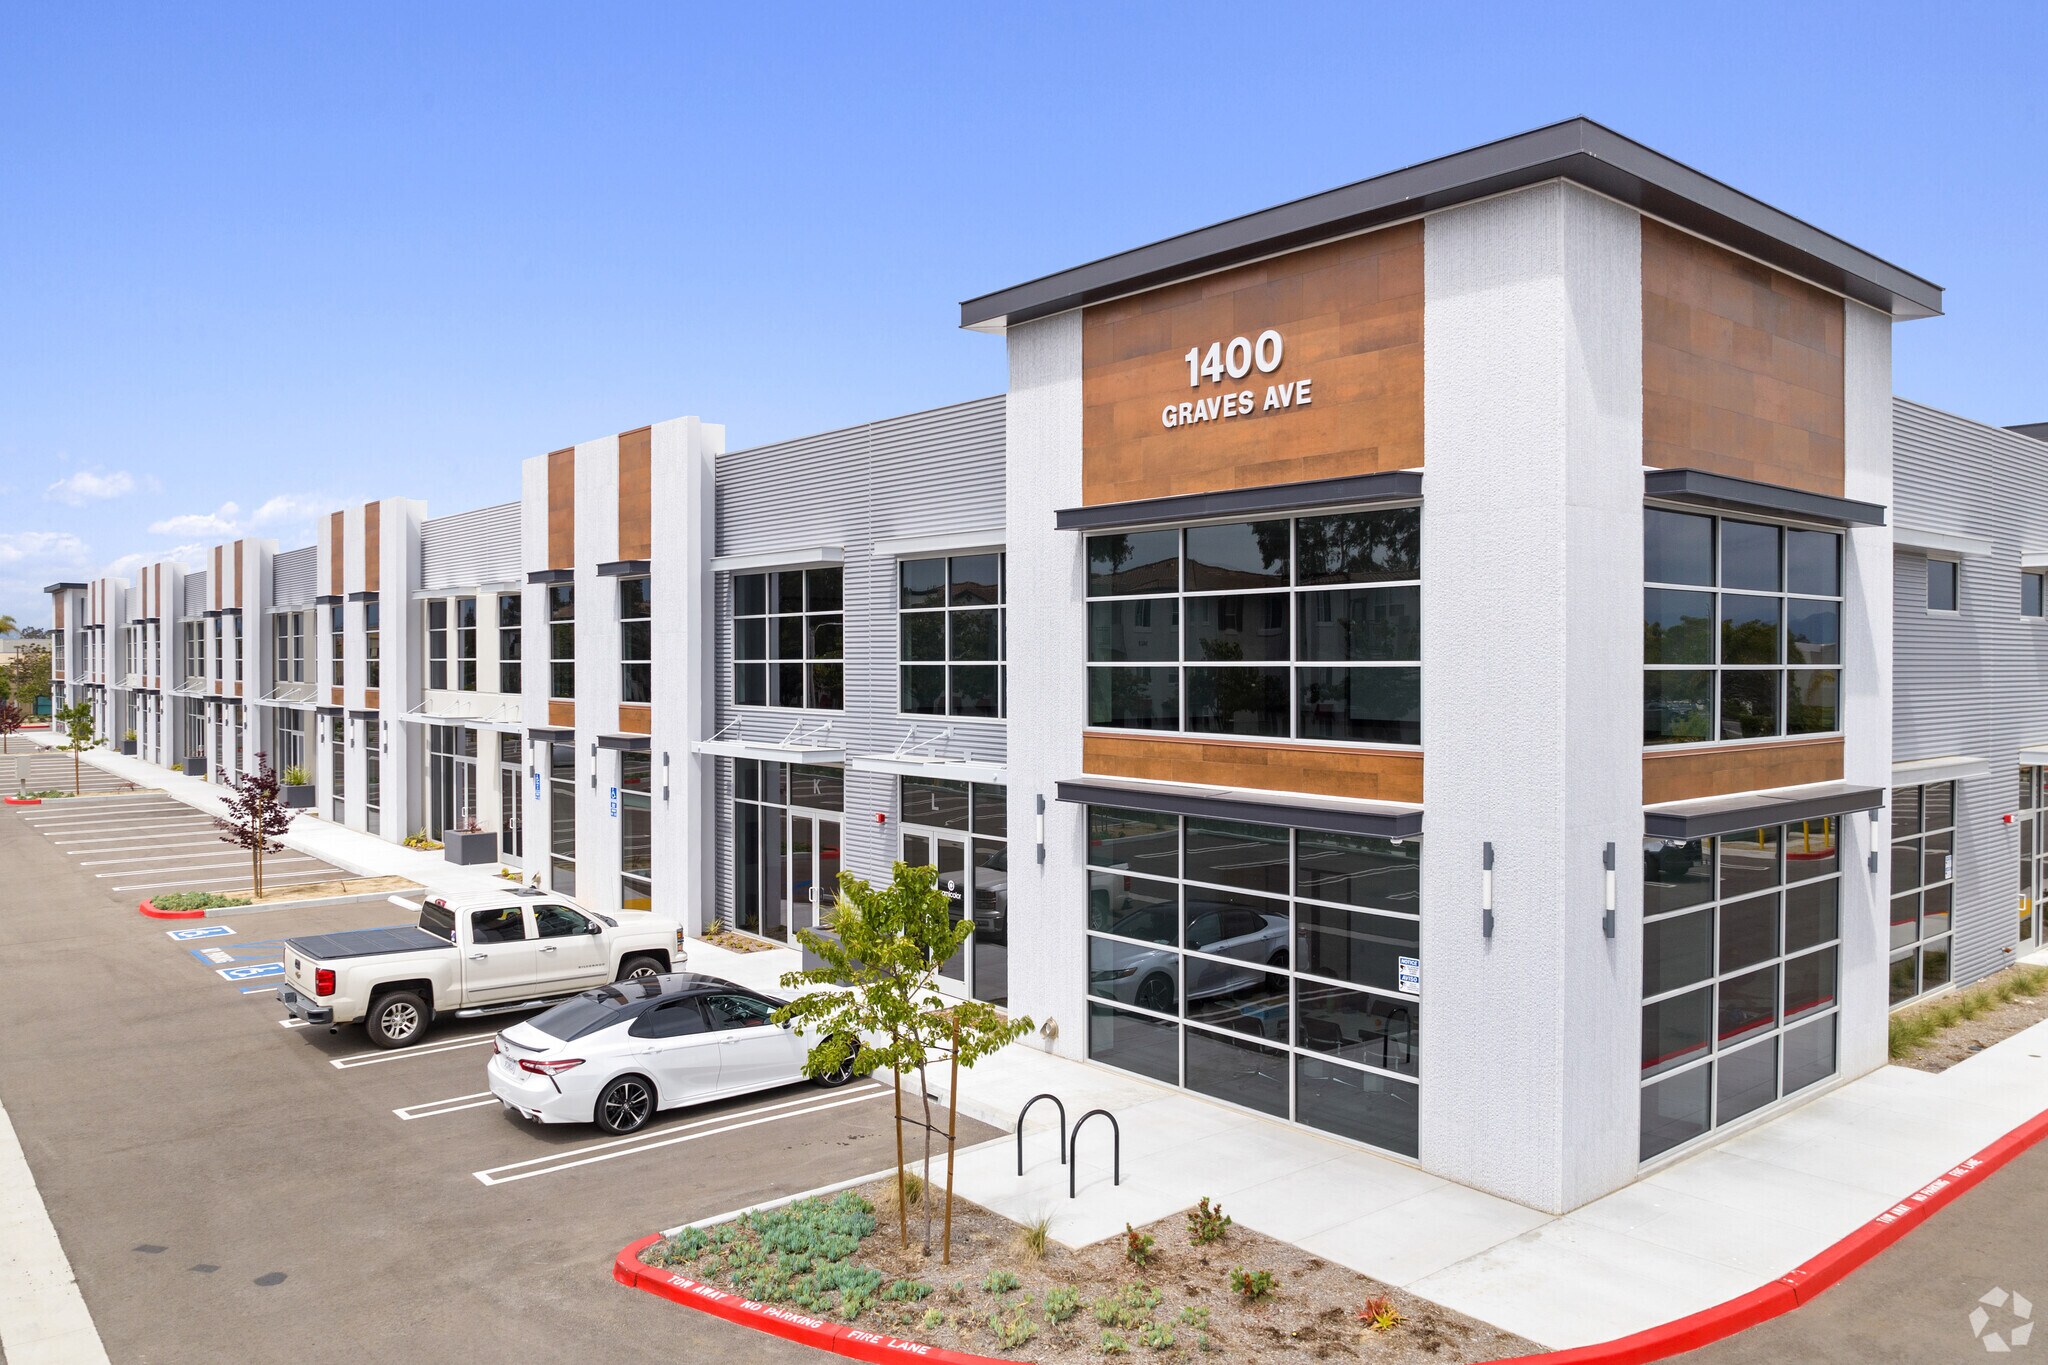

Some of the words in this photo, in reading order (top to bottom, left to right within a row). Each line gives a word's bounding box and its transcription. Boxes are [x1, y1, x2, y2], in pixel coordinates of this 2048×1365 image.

[1184, 329, 1284, 388] 1400
[1162, 390, 1255, 429] GRAVES
[1263, 379, 1312, 412] AVE
[813, 779, 822, 795] K
[931, 793, 939, 810] L
[667, 1275, 695, 1289] TOW
[692, 1285, 729, 1300] AWAY
[740, 1300, 763, 1311] NO
[763, 1308, 824, 1329] PARKING
[847, 1330, 883, 1344] FIRE
[887, 1339, 931, 1355] LANE
